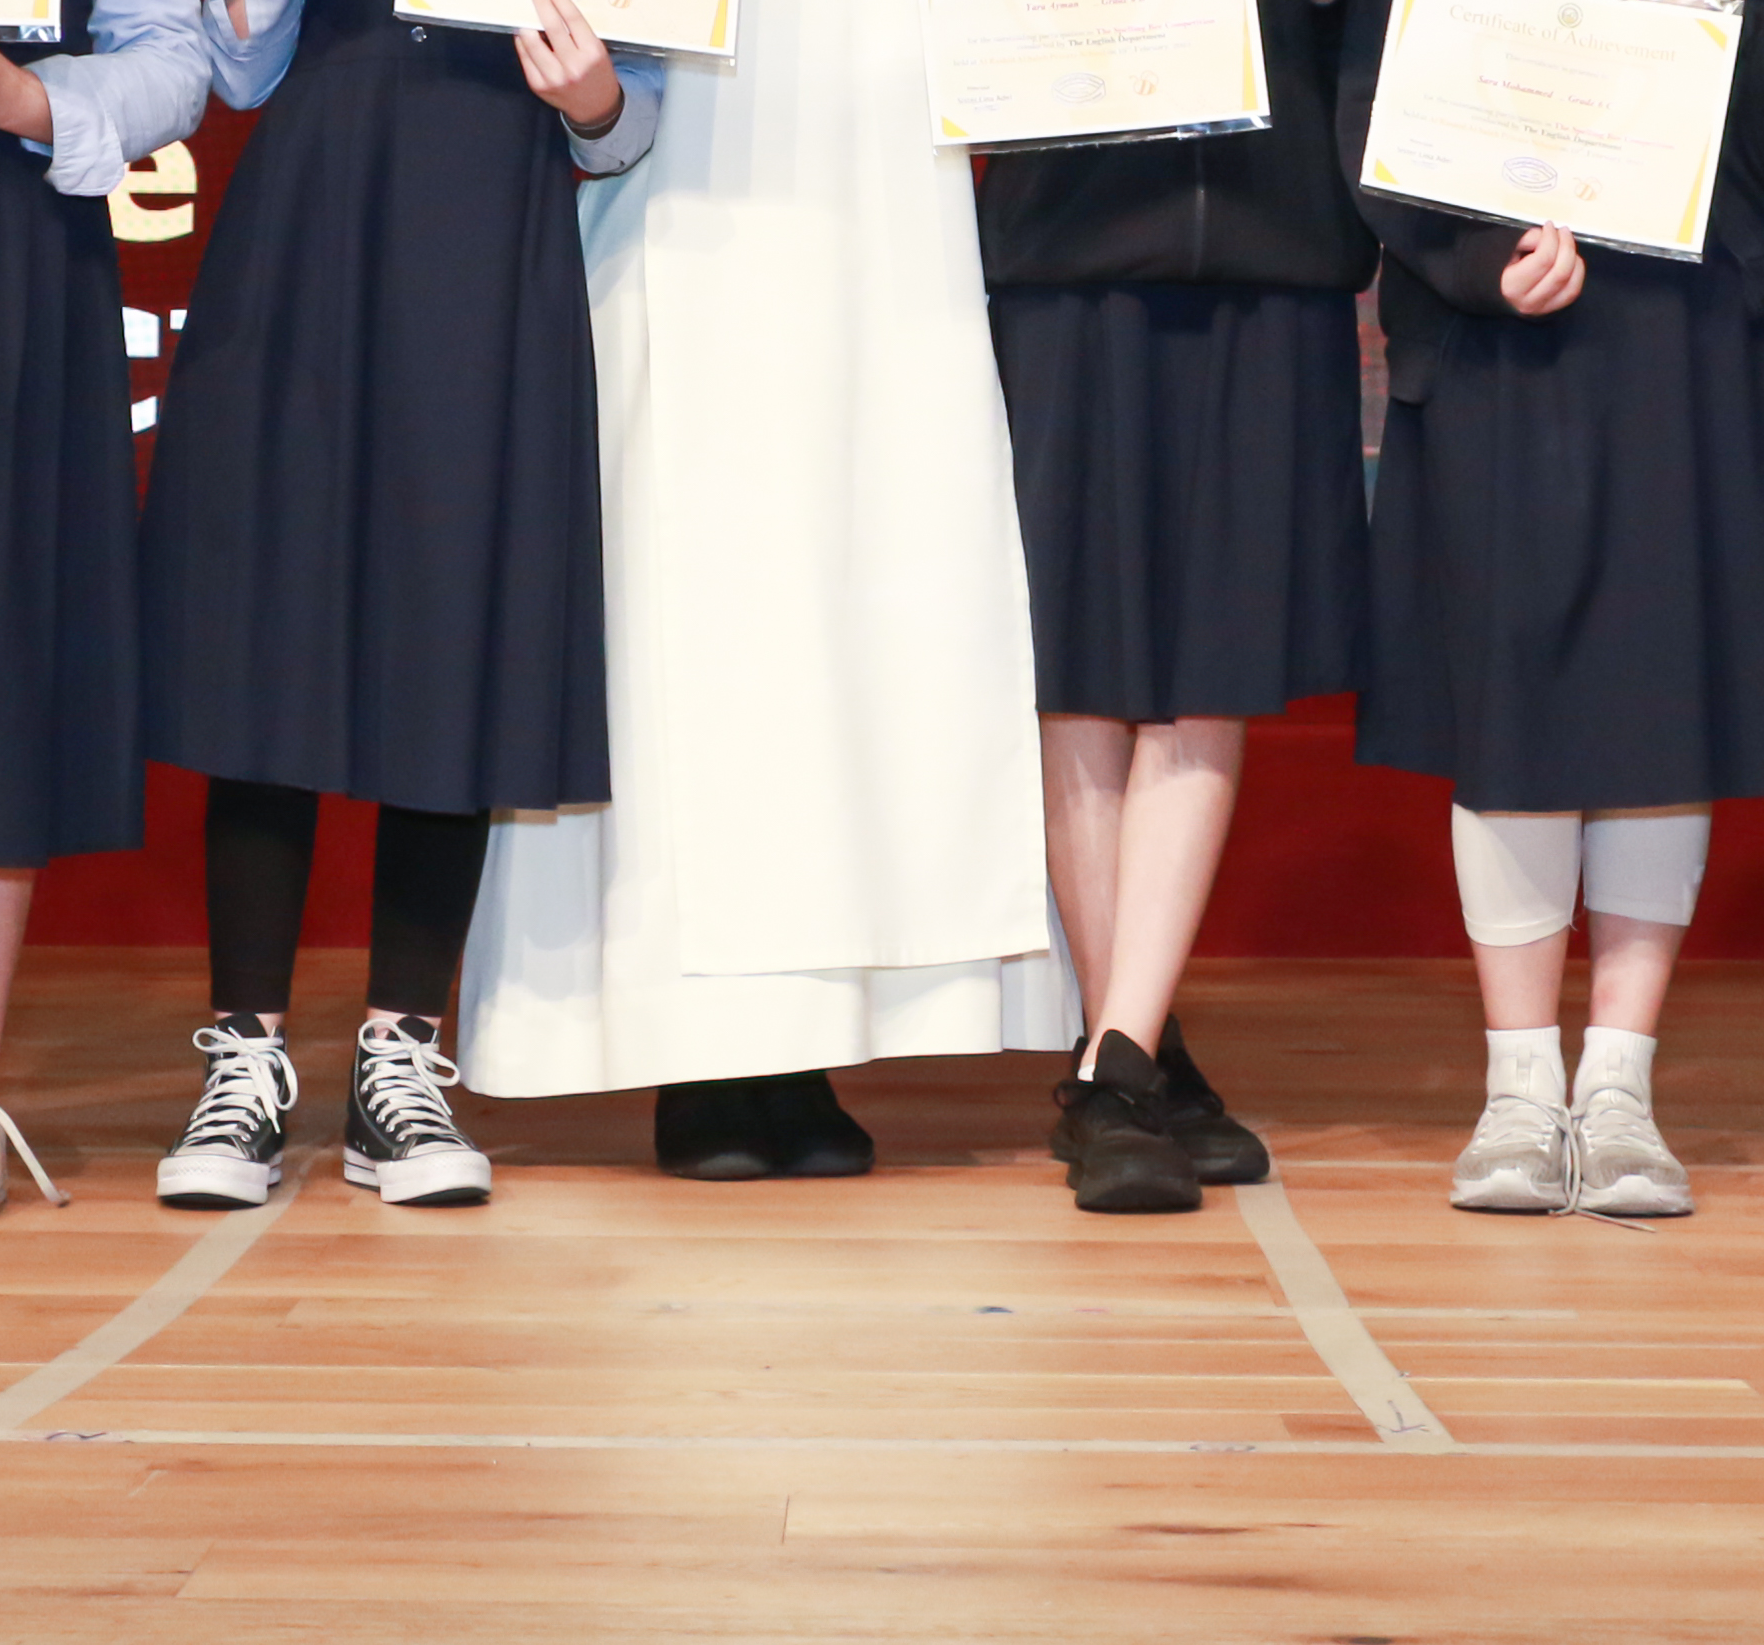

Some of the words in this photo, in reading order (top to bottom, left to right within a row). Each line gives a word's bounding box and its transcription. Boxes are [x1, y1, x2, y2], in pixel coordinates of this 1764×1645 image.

[1069, 38, 1084, 46] The
[1086, 35, 1116, 46] English
[1118, 30, 1166, 43] Department
[1448, 3, 1537, 36] Certificate
[1539, 22, 1561, 41] of
[1563, 25, 1677, 63] Achievement
[1523, 124, 1539, 134] The
[1540, 128, 1571, 142] English
[1573, 134, 1622, 152] Department
